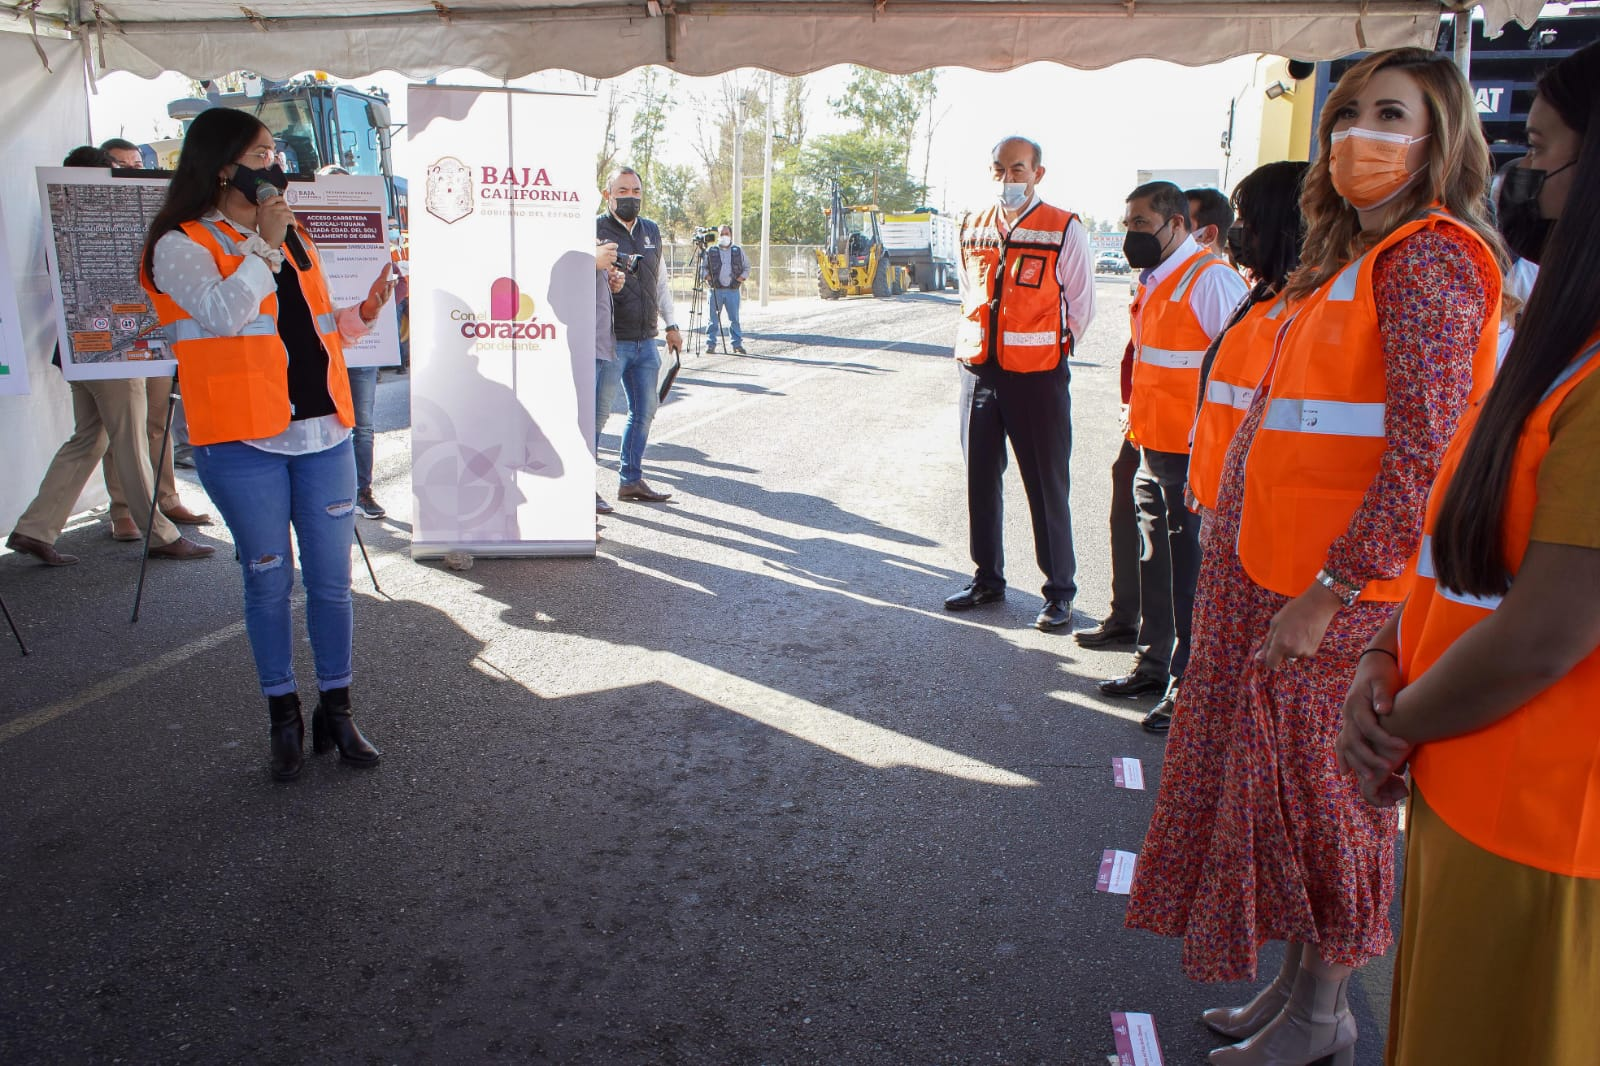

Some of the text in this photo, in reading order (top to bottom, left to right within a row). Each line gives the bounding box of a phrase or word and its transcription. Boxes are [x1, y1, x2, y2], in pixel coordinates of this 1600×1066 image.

[1473, 88, 1504, 113] AT
[481, 166, 551, 188] BAJA
[481, 188, 580, 202] CALIFORNIA
[480, 209, 525, 217] GOBIERNO
[547, 210, 581, 219] ESTADO
[450, 309, 487, 321] Con el
[460, 317, 556, 340] corazón
[475, 340, 542, 352] por delante.
